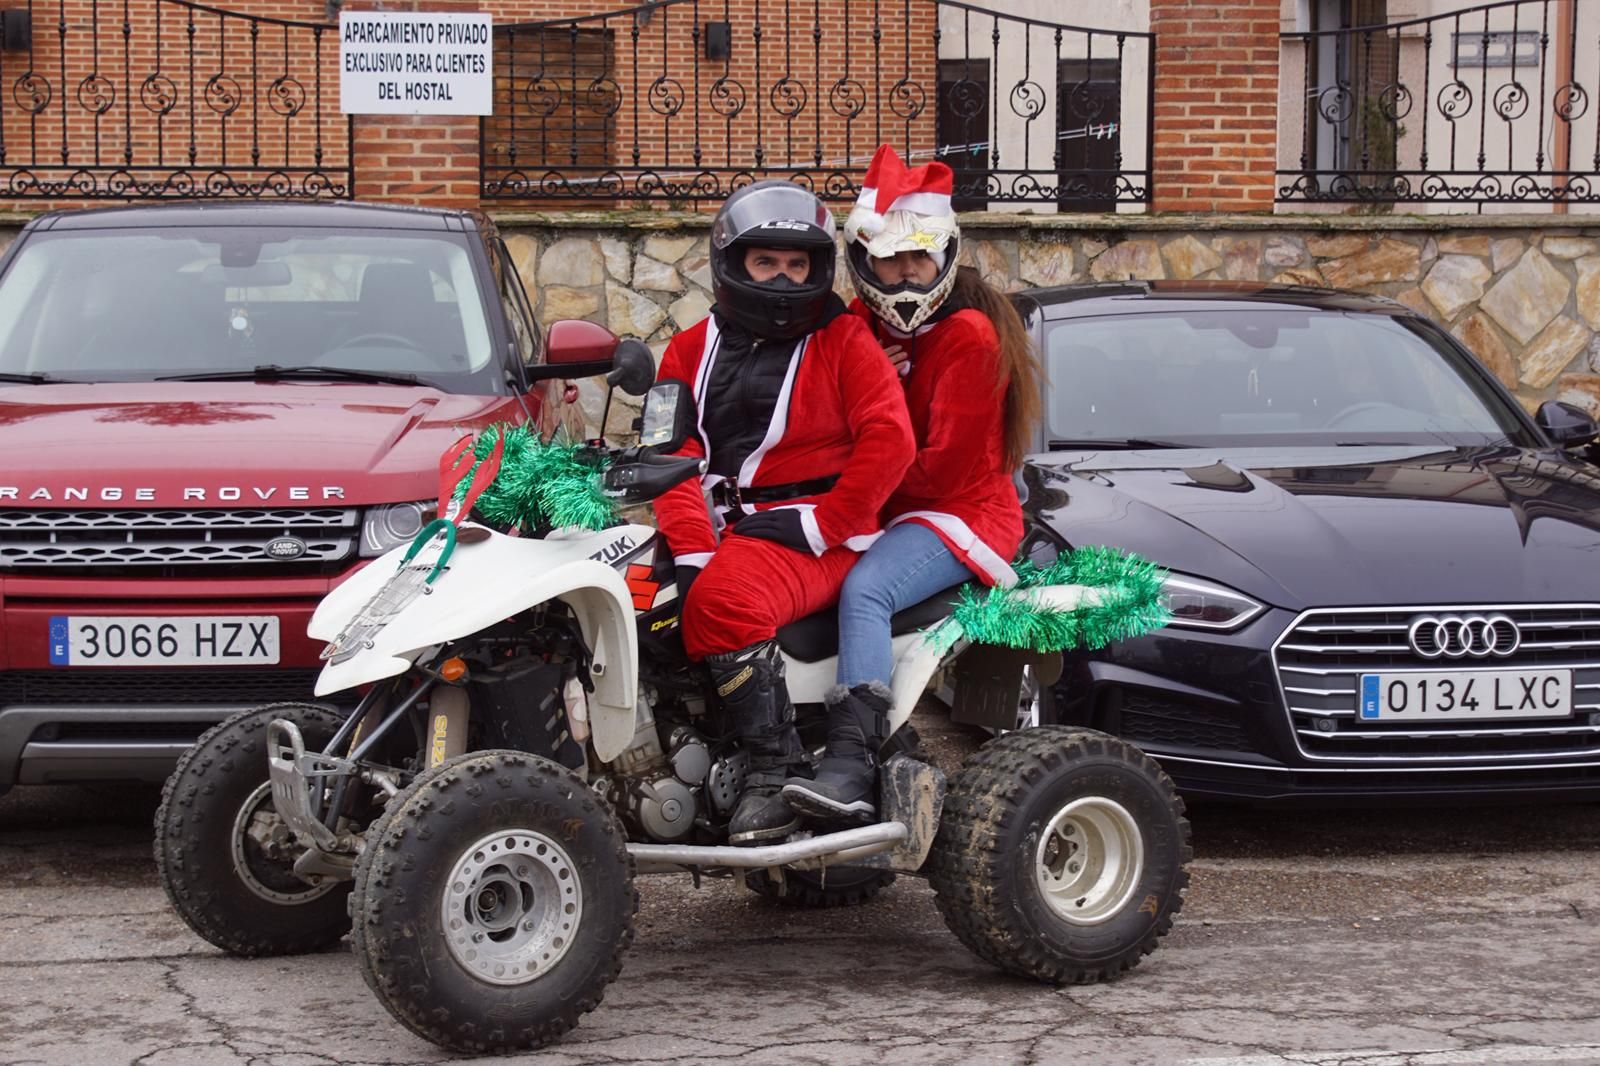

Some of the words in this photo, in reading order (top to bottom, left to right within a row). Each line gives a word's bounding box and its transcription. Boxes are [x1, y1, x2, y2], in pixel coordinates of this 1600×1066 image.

[344, 22, 434, 44] APARCAMIENTO
[438, 23, 488, 44] PRIVADO
[345, 53, 403, 72] EXCLUSIVO
[406, 53, 432, 73] PARA
[435, 54, 485, 73] CLIENTES
[378, 82, 401, 100] DEL
[405, 83, 453, 101] HOSTAL
[0, 487, 156, 501] RANGE
[184, 486, 345, 500] ROVER
[55, 645, 63, 655] E
[79, 623, 178, 658] 3066
[195, 623, 269, 657] HZX
[1367, 701, 1375, 712] E
[1387, 678, 1479, 713] 0134
[1494, 676, 1560, 711] LXC
[431, 714, 448, 768] SUZ
